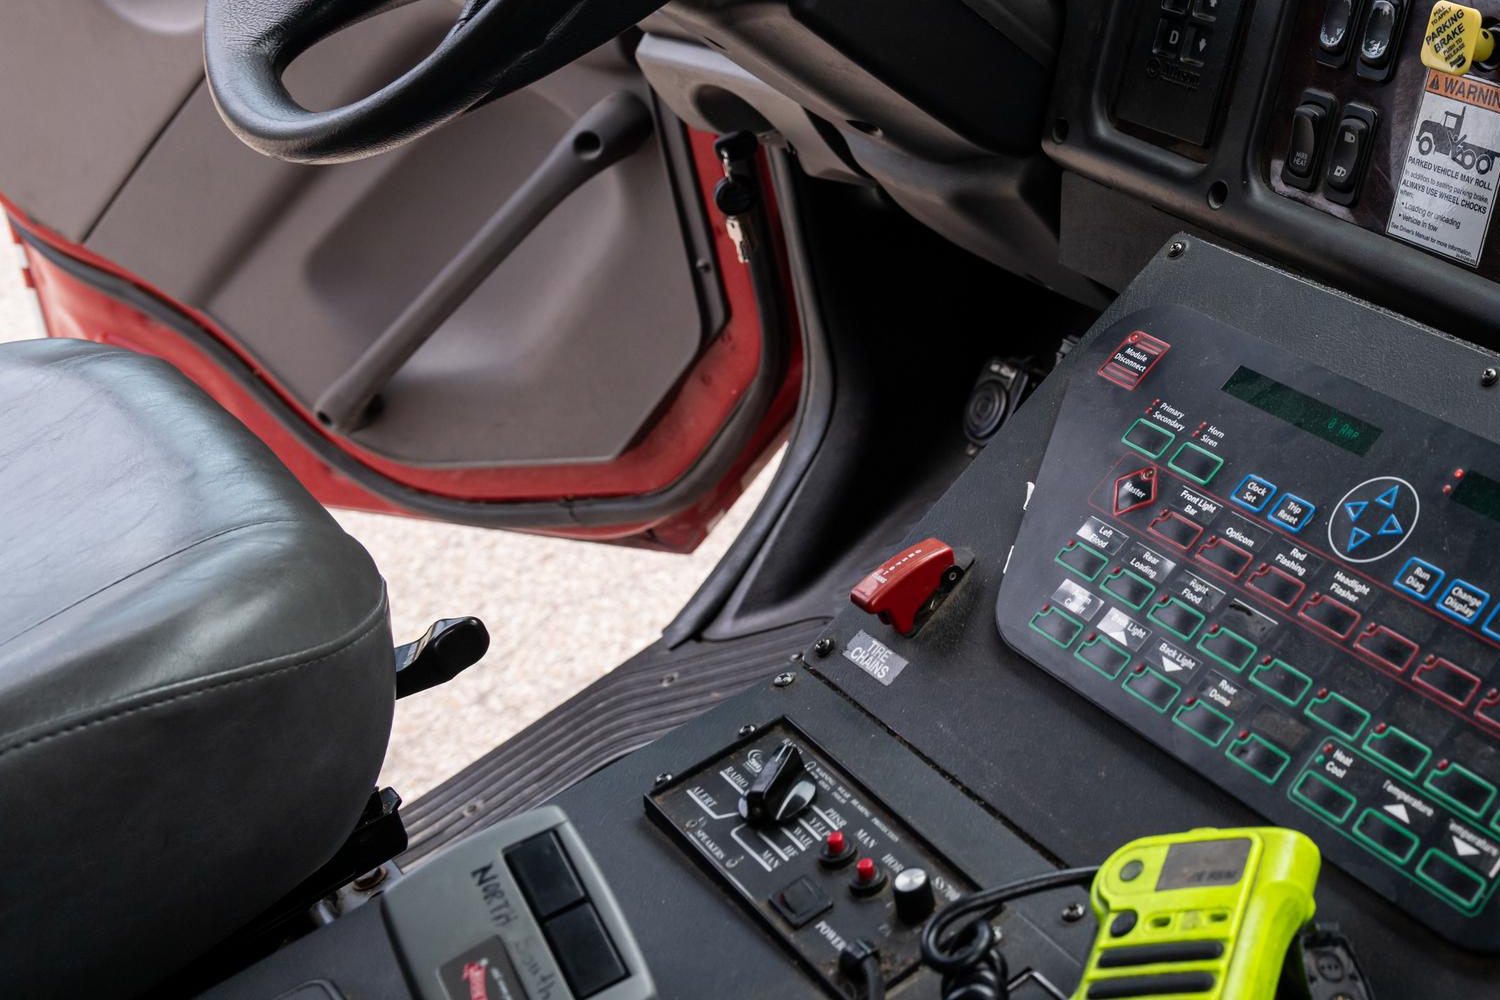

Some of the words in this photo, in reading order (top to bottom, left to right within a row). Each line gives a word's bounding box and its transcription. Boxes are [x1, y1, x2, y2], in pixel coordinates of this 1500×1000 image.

[1168, 30, 1179, 44] D
[1426, 9, 1465, 46] PARKING
[1433, 23, 1465, 54] BRAKE
[1443, 43, 1456, 56] PUSH
[1407, 156, 1433, 171] PARKED
[1433, 163, 1460, 180] VEHICLE
[1460, 173, 1475, 184] MAY
[1409, 171, 1431, 183] addition
[1453, 185, 1474, 200] parking
[1401, 179, 1426, 193] ALWAYS
[1425, 185, 1438, 198] USE
[1438, 192, 1460, 206] WHEEL
[1460, 199, 1487, 215] CHOCKS
[1402, 214, 1421, 227] Vehicle
[1427, 222, 1438, 232] tow
[1404, 201, 1427, 217] Loading
[1433, 212, 1461, 229] unloading
[1114, 352, 1147, 373] Disconnect
[1125, 347, 1148, 363] Module
[1153, 410, 1185, 432] Secondary
[1160, 402, 1185, 420] Primary
[1200, 434, 1218, 448] Siren
[1207, 425, 1225, 439] Horn
[1124, 481, 1147, 499] Master
[1243, 491, 1257, 503] Set
[1247, 481, 1267, 497] Clock
[1180, 489, 1201, 505] Front
[1199, 497, 1218, 514] Light
[1184, 503, 1198, 516] Bar
[1288, 502, 1302, 514] Trip
[1277, 510, 1299, 525] Reset
[1089, 534, 1109, 549] Flood
[1098, 525, 1113, 539] Left
[1225, 527, 1255, 547] Opticom
[1142, 551, 1160, 566] Rear
[1275, 553, 1307, 576] Flashing
[1290, 548, 1307, 561] Red
[1130, 557, 1157, 580] Loading
[1413, 567, 1431, 581] Run
[1188, 578, 1209, 596] Right
[1330, 583, 1359, 604] Flasher
[1334, 571, 1370, 596] Headlight
[1405, 575, 1425, 593] Diag
[1181, 588, 1203, 604] Flood
[1451, 586, 1483, 608] Change
[1444, 596, 1475, 619] Display
[1127, 623, 1147, 640] Light
[866, 640, 893, 664] TIRE
[1158, 642, 1176, 657] Back
[1175, 652, 1196, 670] Light
[850, 646, 890, 679] CHAINS
[1219, 679, 1238, 695] Rear
[1208, 688, 1231, 708] Dome
[1332, 748, 1354, 767] Heat
[723, 766, 750, 788] RADIO
[1325, 760, 1347, 778] Cool
[691, 785, 718, 808] ALERT
[808, 817, 829, 836] YELP
[696, 829, 726, 861] SPEAKERS
[793, 827, 813, 848] WAIL
[854, 828, 878, 849] MAN
[760, 849, 781, 869] MAN
[783, 844, 798, 858] HF
[470, 861, 520, 928] NORTH
[815, 920, 849, 952] POWER
